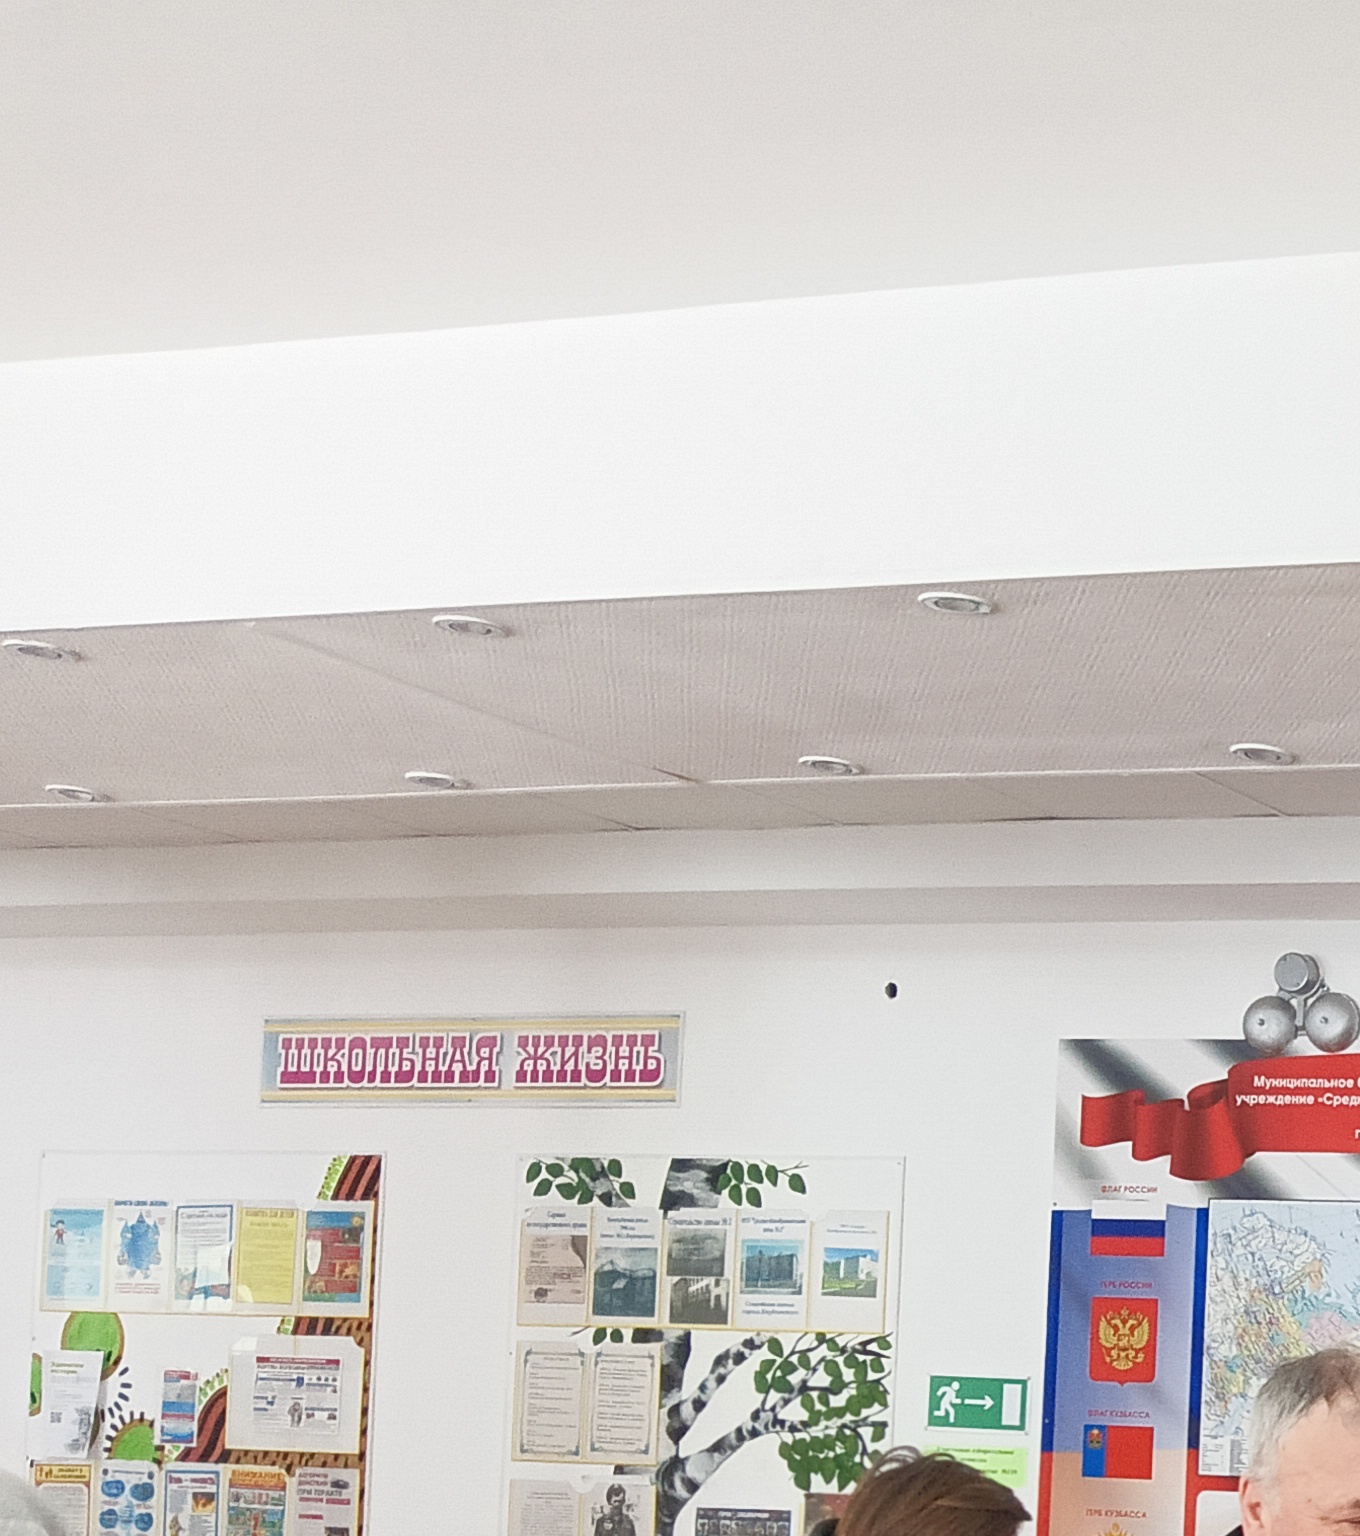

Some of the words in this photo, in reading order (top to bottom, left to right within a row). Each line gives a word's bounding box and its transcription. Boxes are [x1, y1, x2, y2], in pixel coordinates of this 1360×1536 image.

[278, 1034, 499, 1087] ШКОЛЬНАЯ
[514, 1032, 666, 1086] ЖИЗНЬ
[1253, 1075, 1355, 1089] Муниципальное
[1235, 1094, 1315, 1106] учреждение
[1123, 1185, 1158, 1194] РОССИИ
[1104, 1510, 1147, 1519] КУЗБАССА
